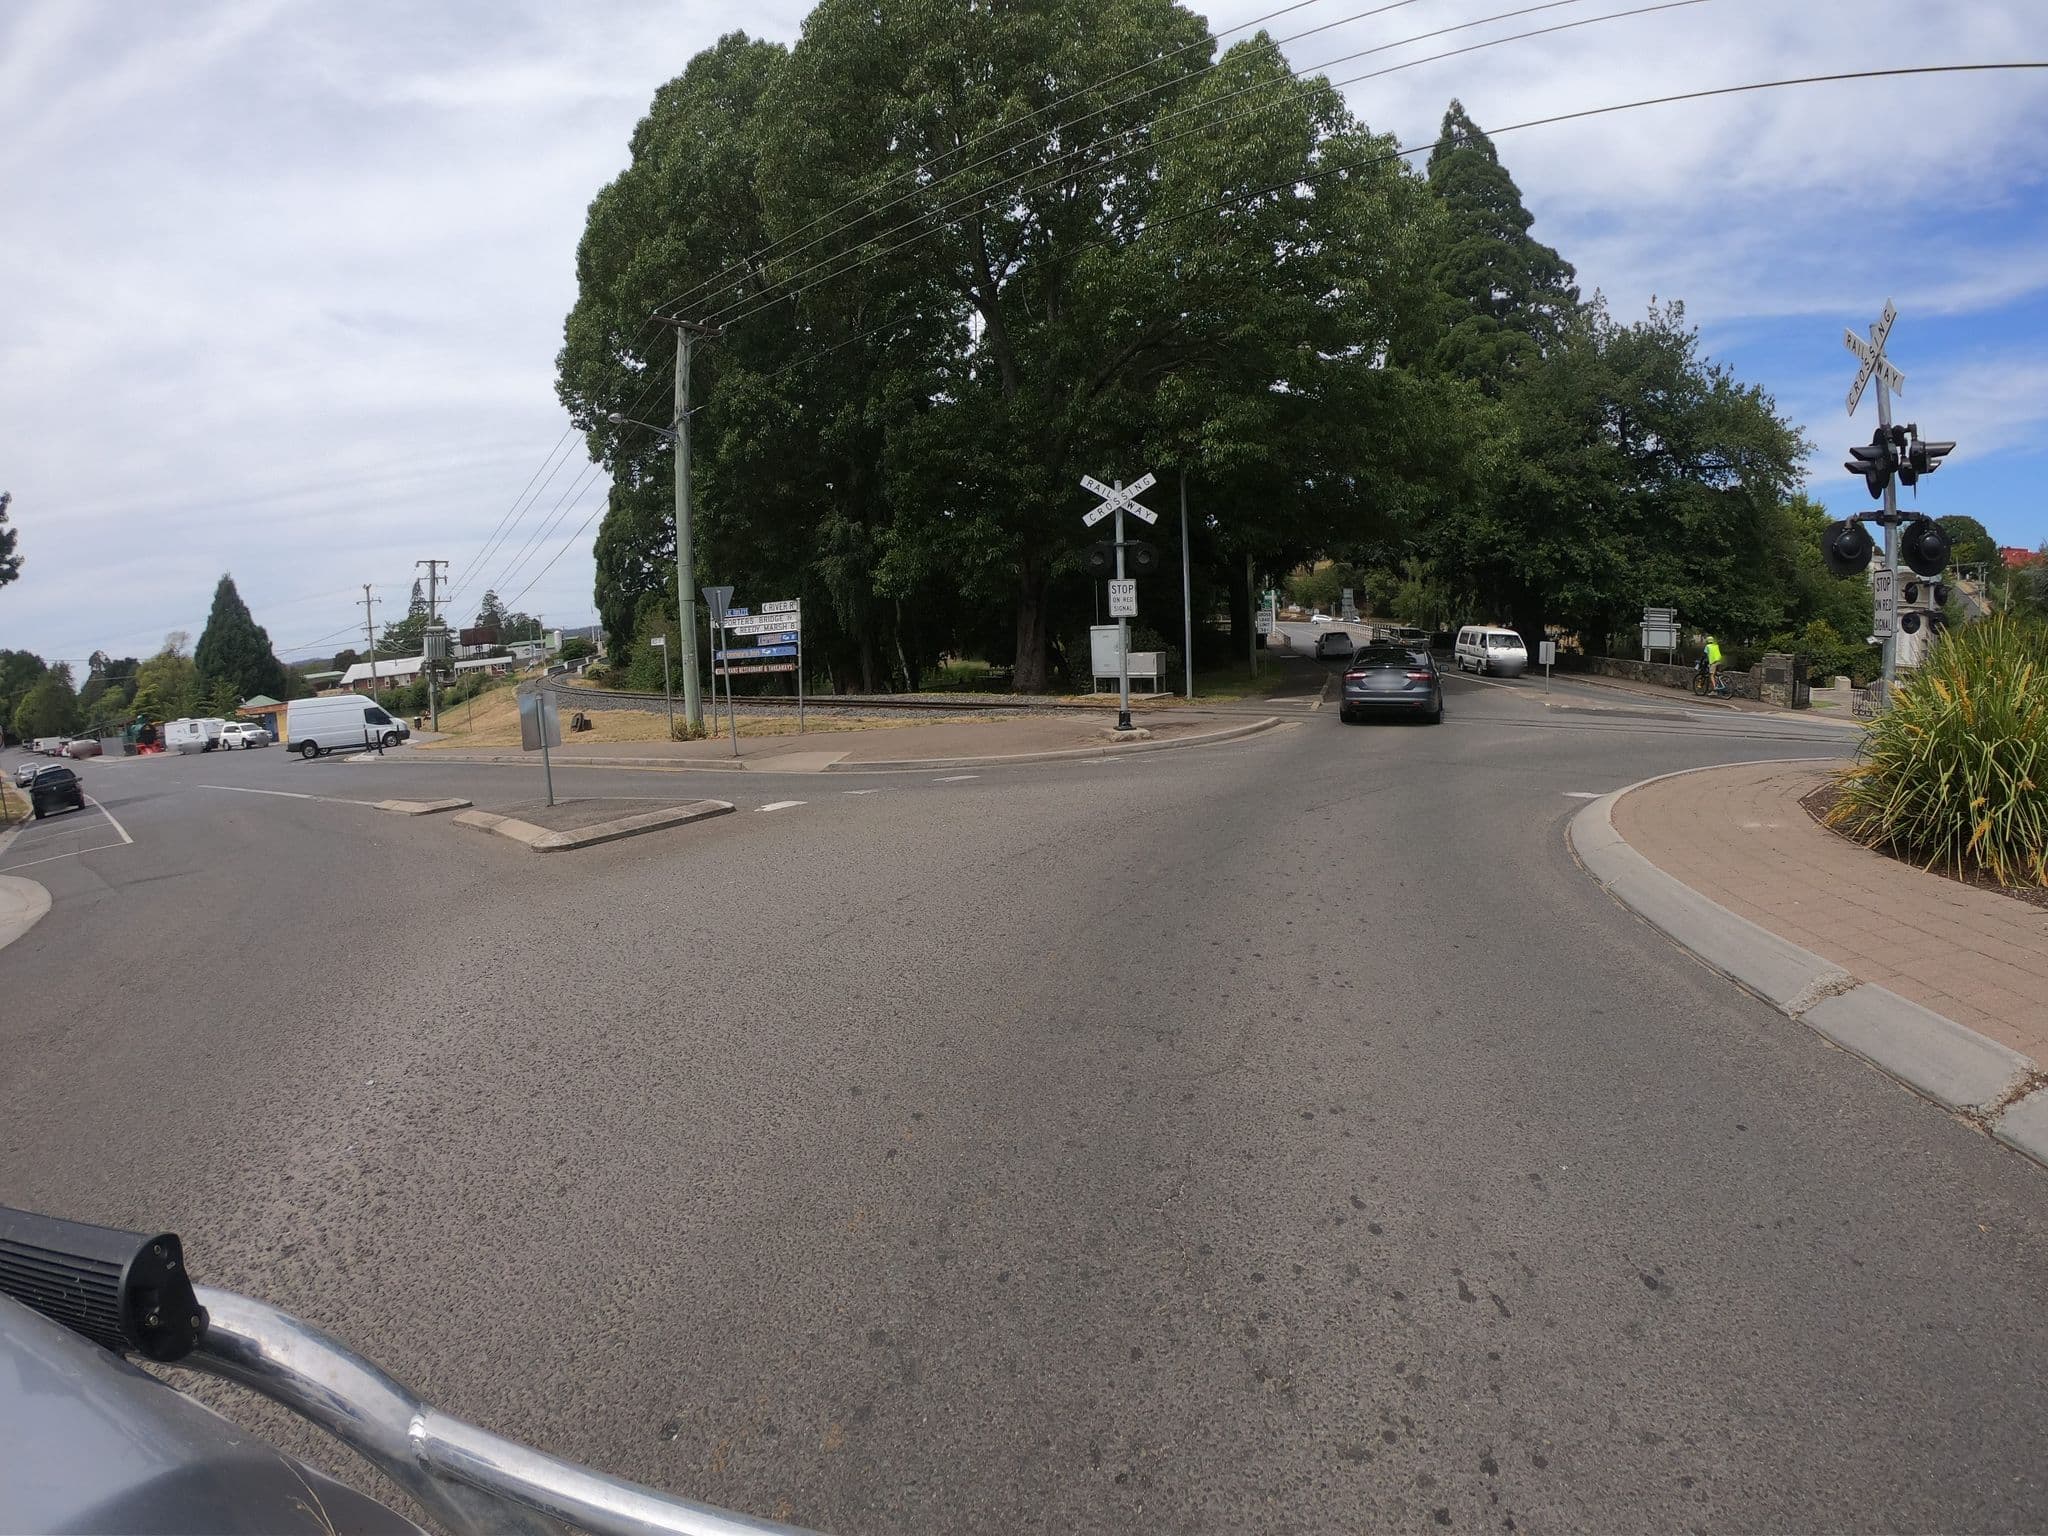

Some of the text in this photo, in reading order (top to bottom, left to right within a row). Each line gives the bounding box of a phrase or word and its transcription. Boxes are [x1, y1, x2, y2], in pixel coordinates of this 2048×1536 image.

[1089, 476, 1151, 522] CROSSING
[1111, 584, 1134, 594] STOP
[1876, 576, 1891, 593] STOP
[767, 602, 788, 611] RIVER
[724, 618, 753, 626] PORTERS
[759, 614, 784, 623] BRIDGE
[763, 623, 788, 631] MARSH
